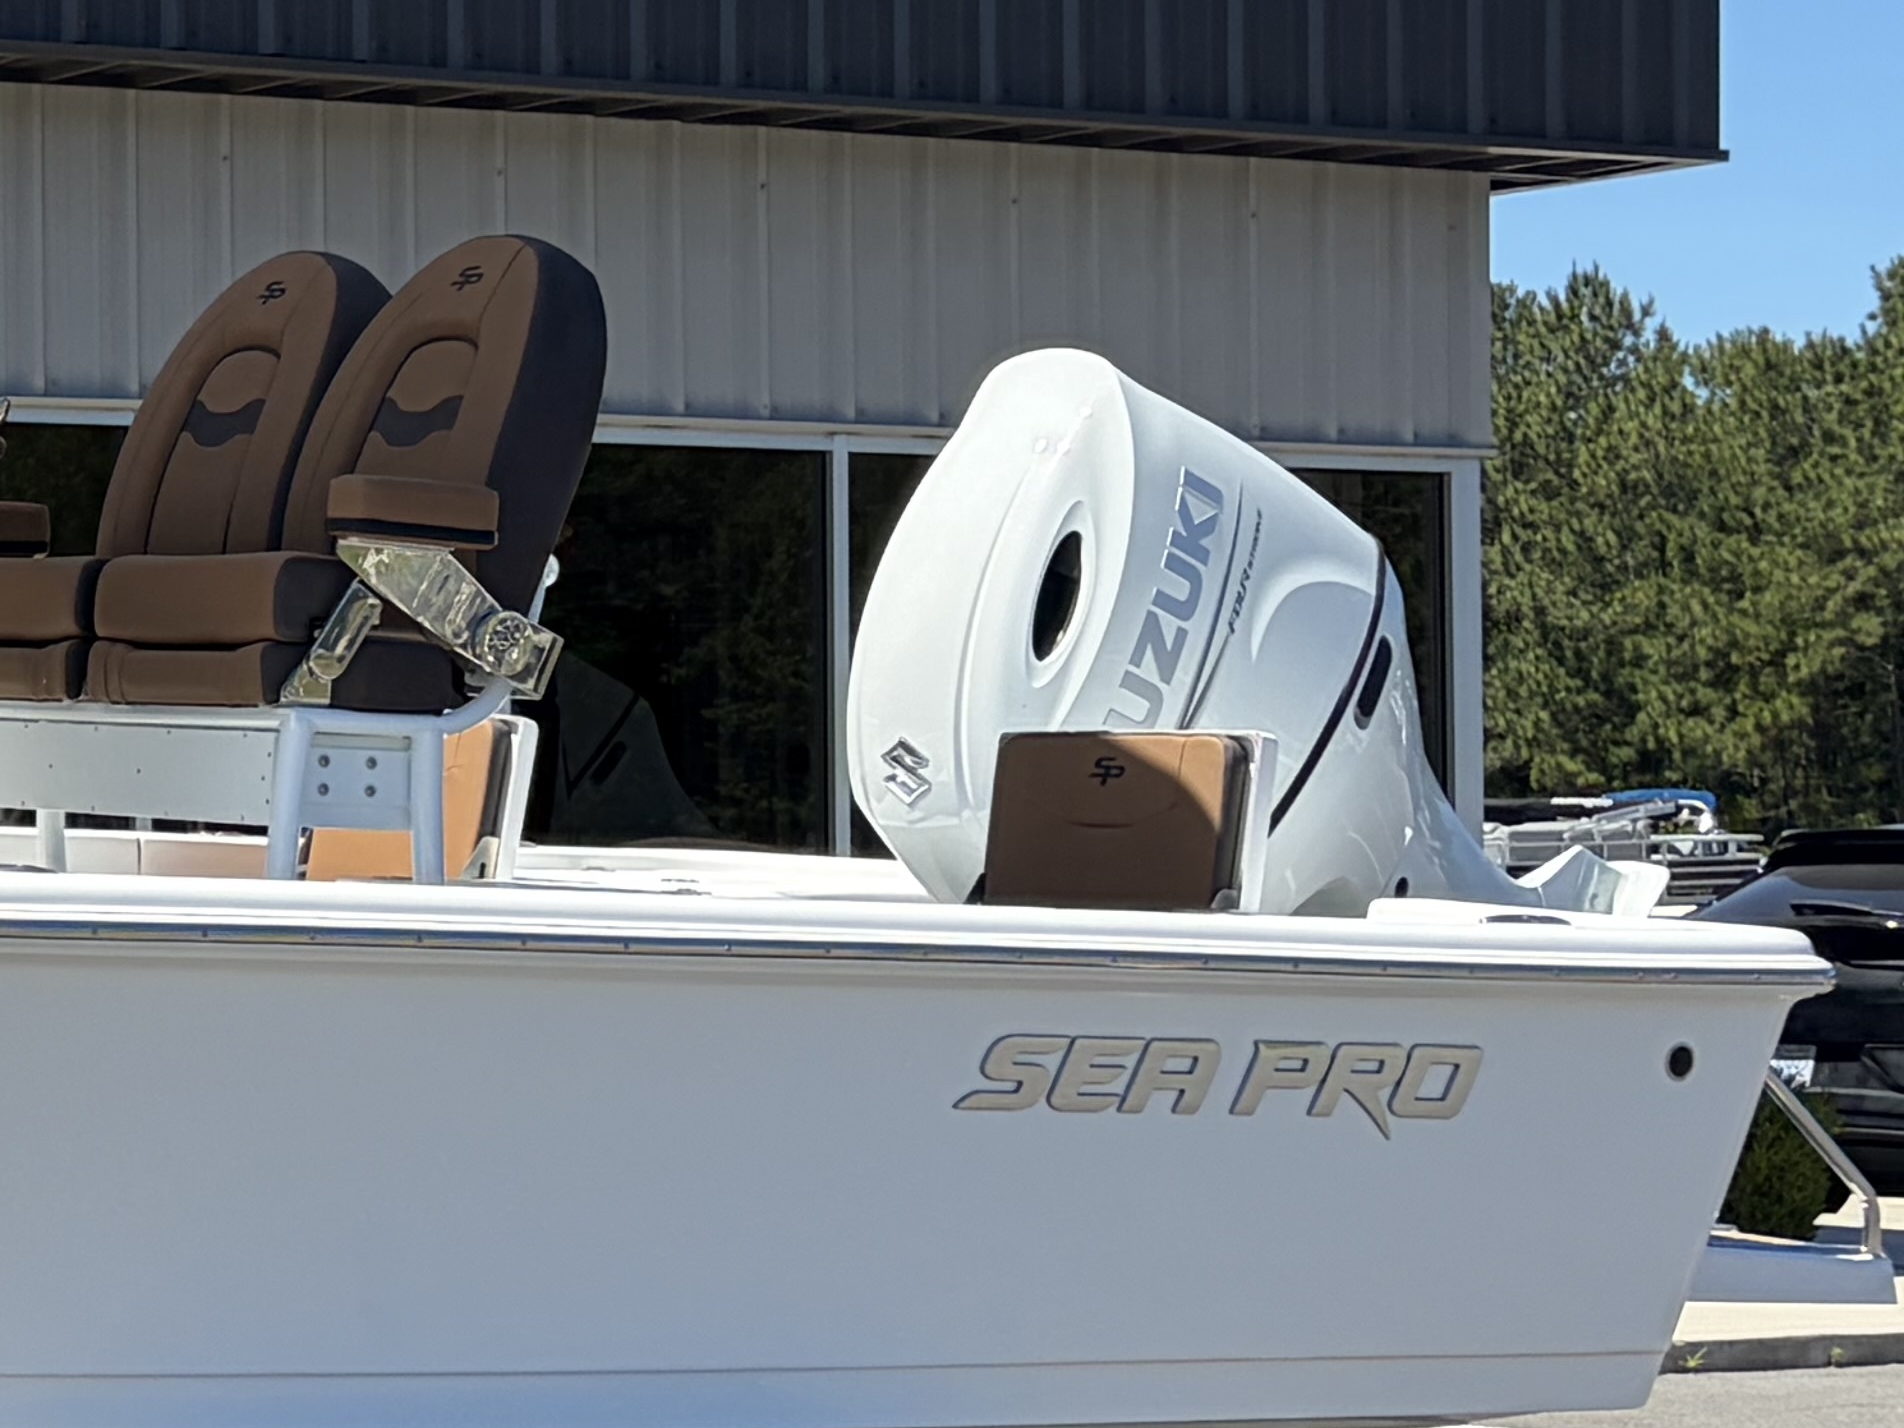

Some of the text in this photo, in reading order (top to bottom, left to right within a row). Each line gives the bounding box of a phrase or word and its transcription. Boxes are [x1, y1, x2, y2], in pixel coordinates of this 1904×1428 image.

[1102, 465, 1224, 730] UZUKI
[952, 1032, 1485, 1141] SEA PRO
